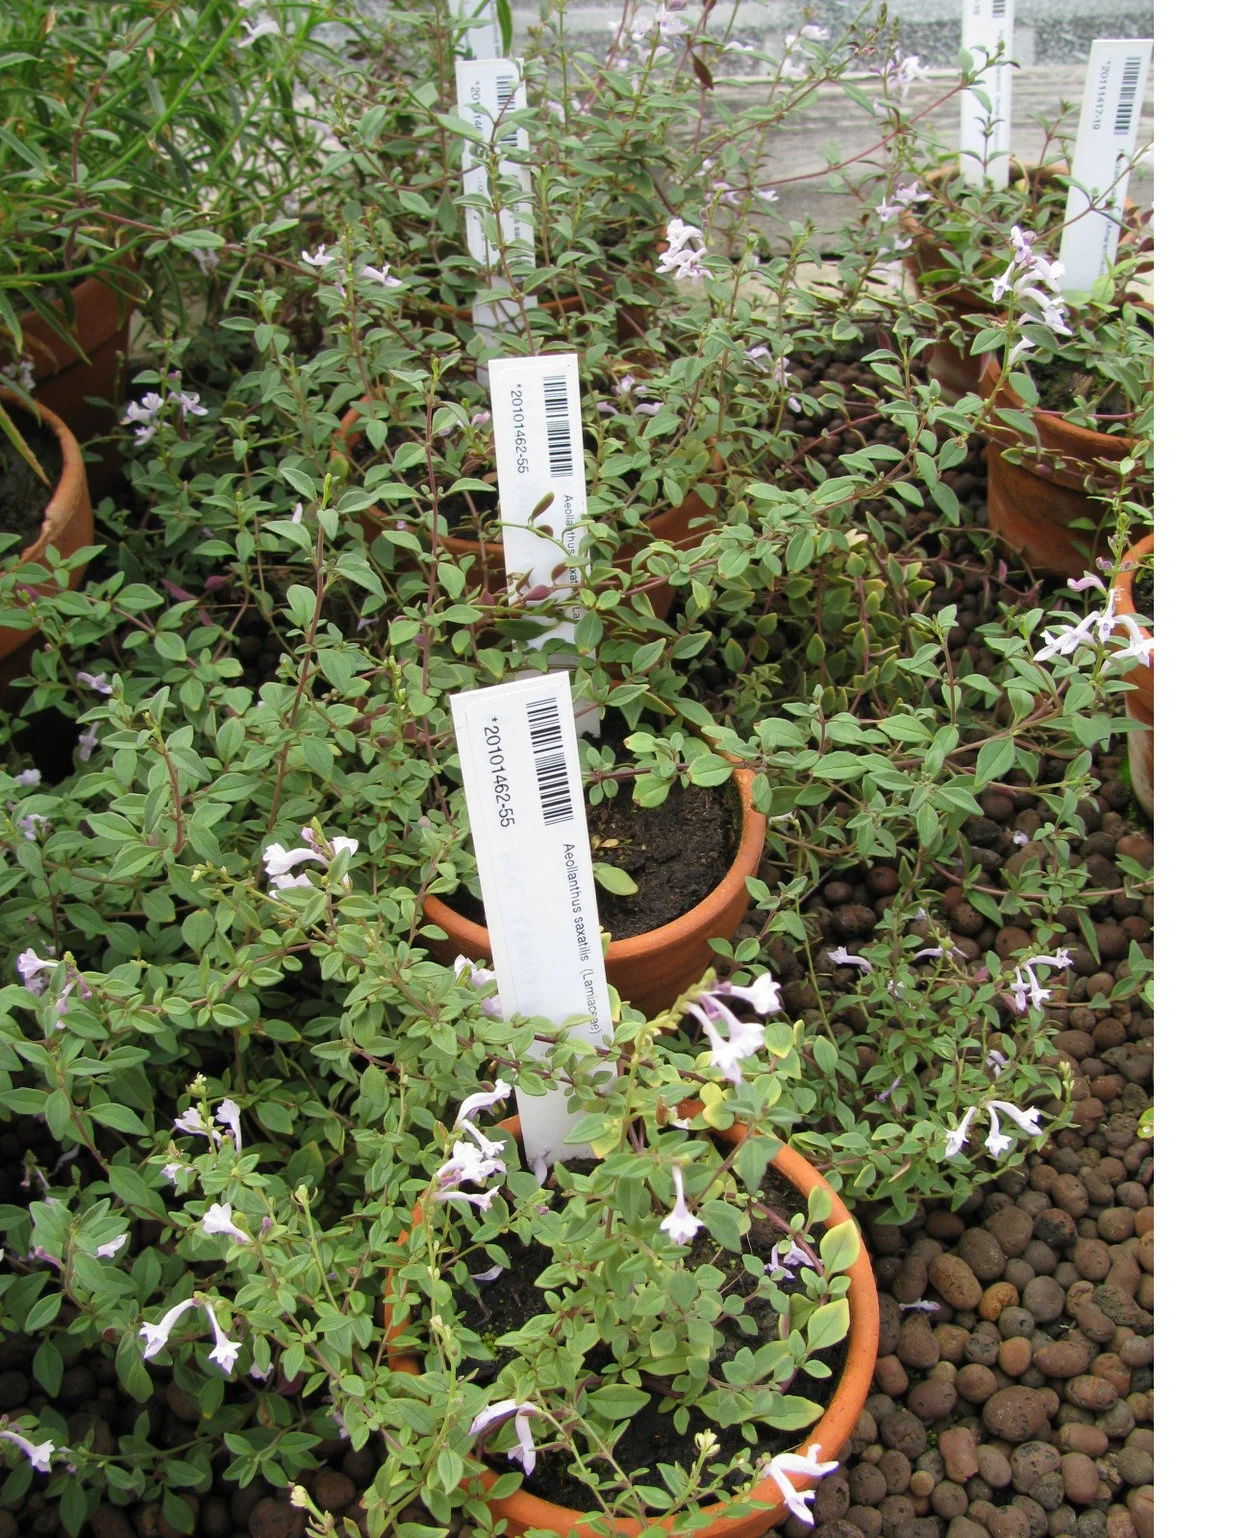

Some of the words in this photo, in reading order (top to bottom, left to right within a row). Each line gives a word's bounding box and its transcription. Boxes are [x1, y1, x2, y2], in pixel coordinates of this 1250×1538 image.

[563, 494, 577, 554] Aeollathus
[562, 842, 582, 913] Aeollanthus
[574, 916, 592, 962] saxatilis
